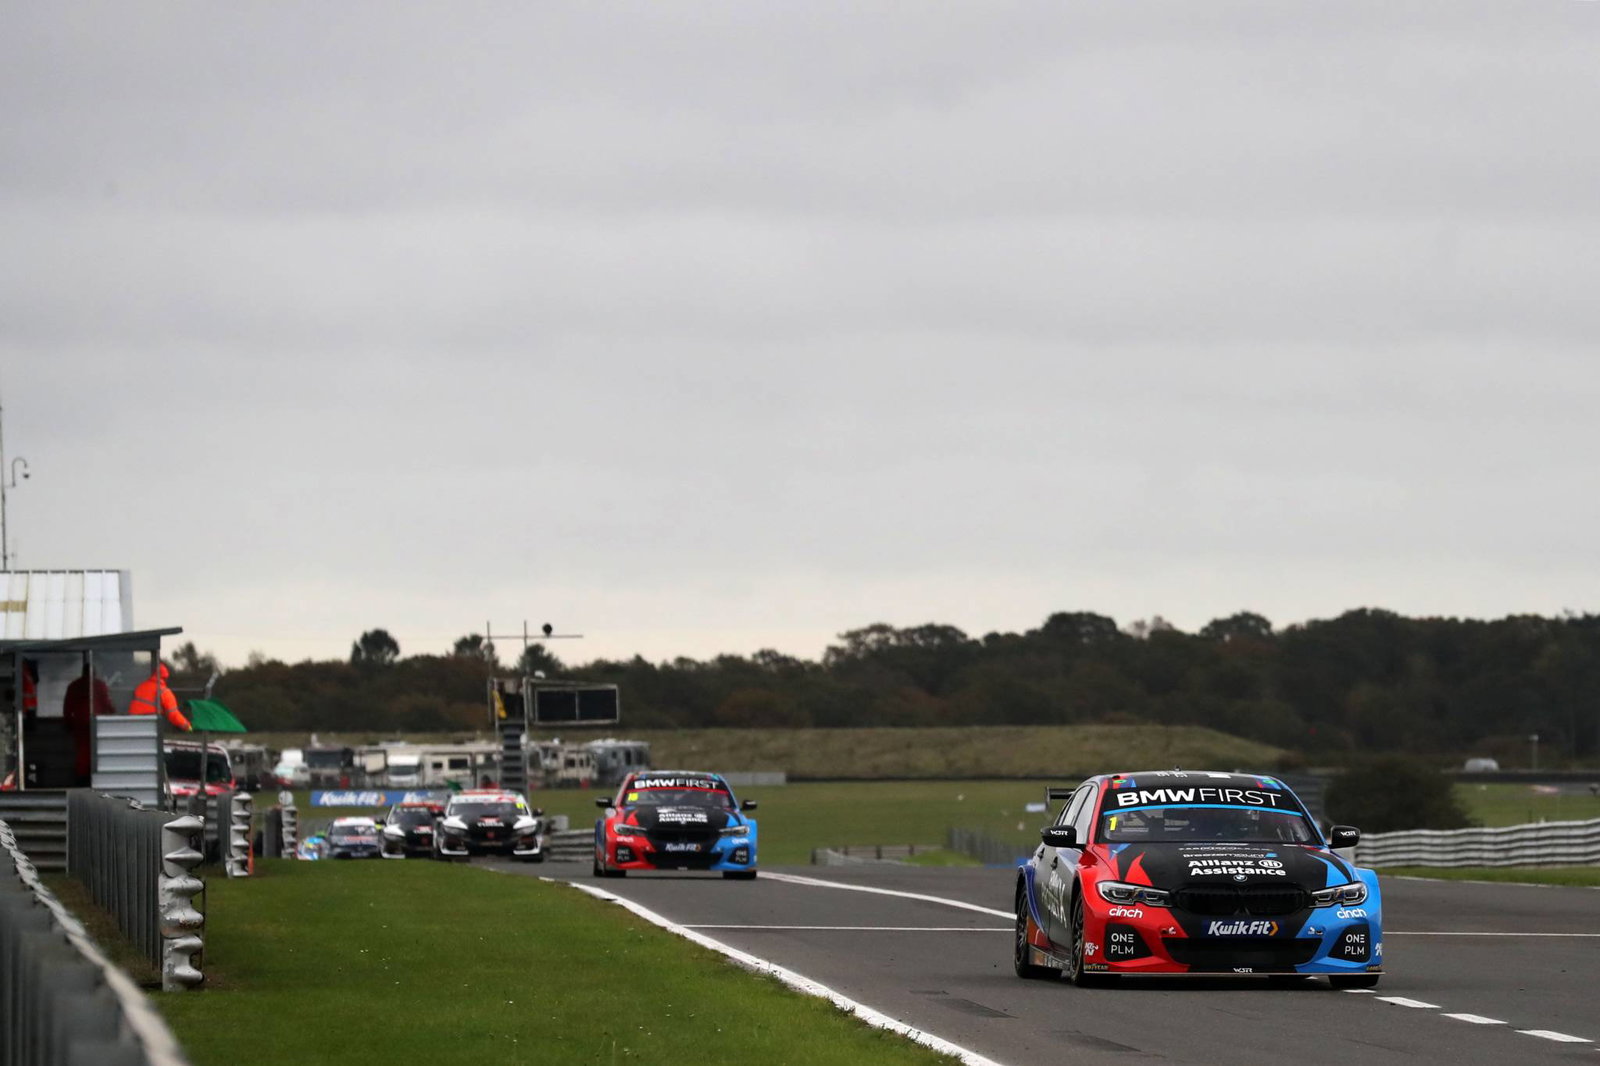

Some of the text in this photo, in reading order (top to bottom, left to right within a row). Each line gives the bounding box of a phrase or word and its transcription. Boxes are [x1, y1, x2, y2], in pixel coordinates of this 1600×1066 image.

[1109, 816, 1118, 831] 1
[1188, 859, 1255, 868] Allianz
[1190, 866, 1286, 876] Assistance
[1108, 905, 1143, 919] cinch
[1336, 907, 1367, 919] cinch
[1111, 932, 1134, 943] ONE
[1345, 933, 1365, 943] ONE
[1110, 944, 1134, 955] PLM
[1344, 945, 1365, 955] PLM
